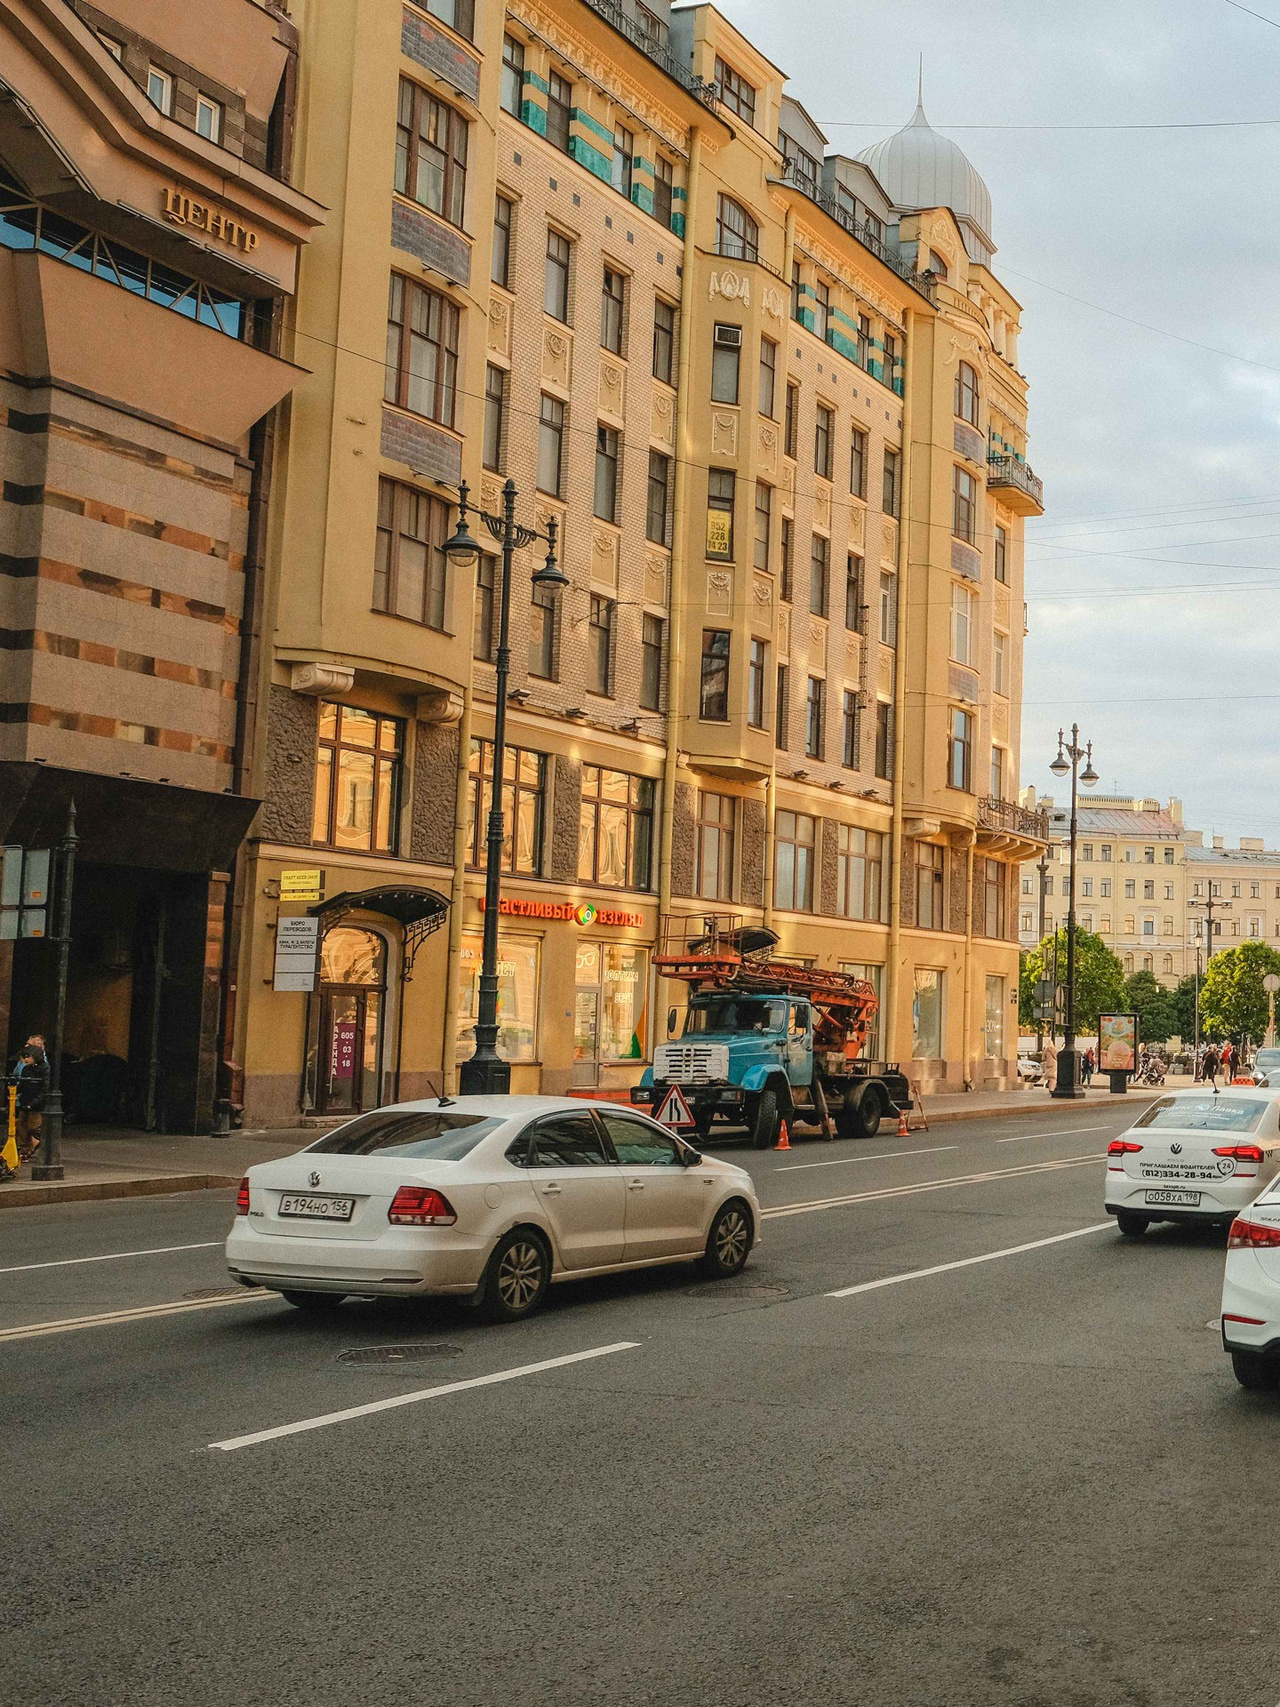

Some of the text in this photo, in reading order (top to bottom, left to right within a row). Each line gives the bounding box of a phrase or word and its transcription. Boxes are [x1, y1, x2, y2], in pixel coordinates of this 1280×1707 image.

[162, 187, 259, 253] ЦЕНТР
[710, 531, 725, 541] 228
[717, 542, 728, 551] 23
[479, 897, 644, 928] астливый взгляд
[340, 1032, 354, 1040] 605
[331, 1025, 339, 1076] АРЕНДА
[1211, 1105, 1244, 1115] Лавка
[1141, 1169, 1212, 1179] (812)334-28-94
[1148, 1192, 1198, 1201] О058ХА 198
[283, 1198, 348, 1213] В194НО 156
